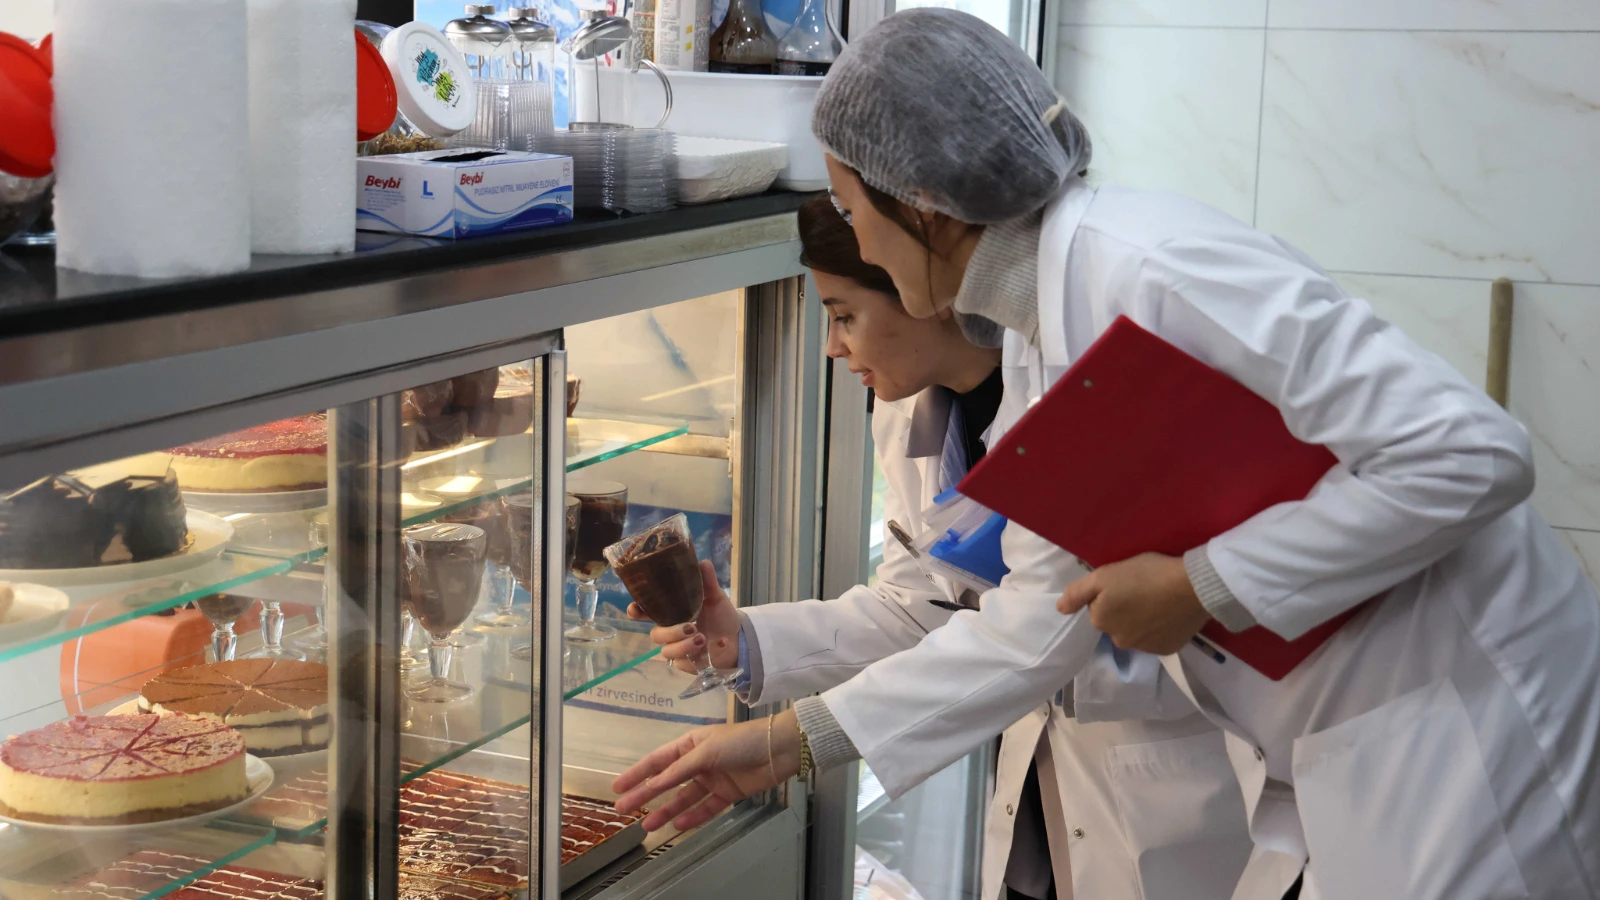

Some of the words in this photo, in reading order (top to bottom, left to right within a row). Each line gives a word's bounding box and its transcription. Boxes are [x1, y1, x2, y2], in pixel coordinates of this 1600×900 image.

[365, 175, 401, 189] Beybi
[460, 172, 484, 186] Beybi
[423, 180, 433, 196] L
[596, 687, 674, 708] zirvesinden
